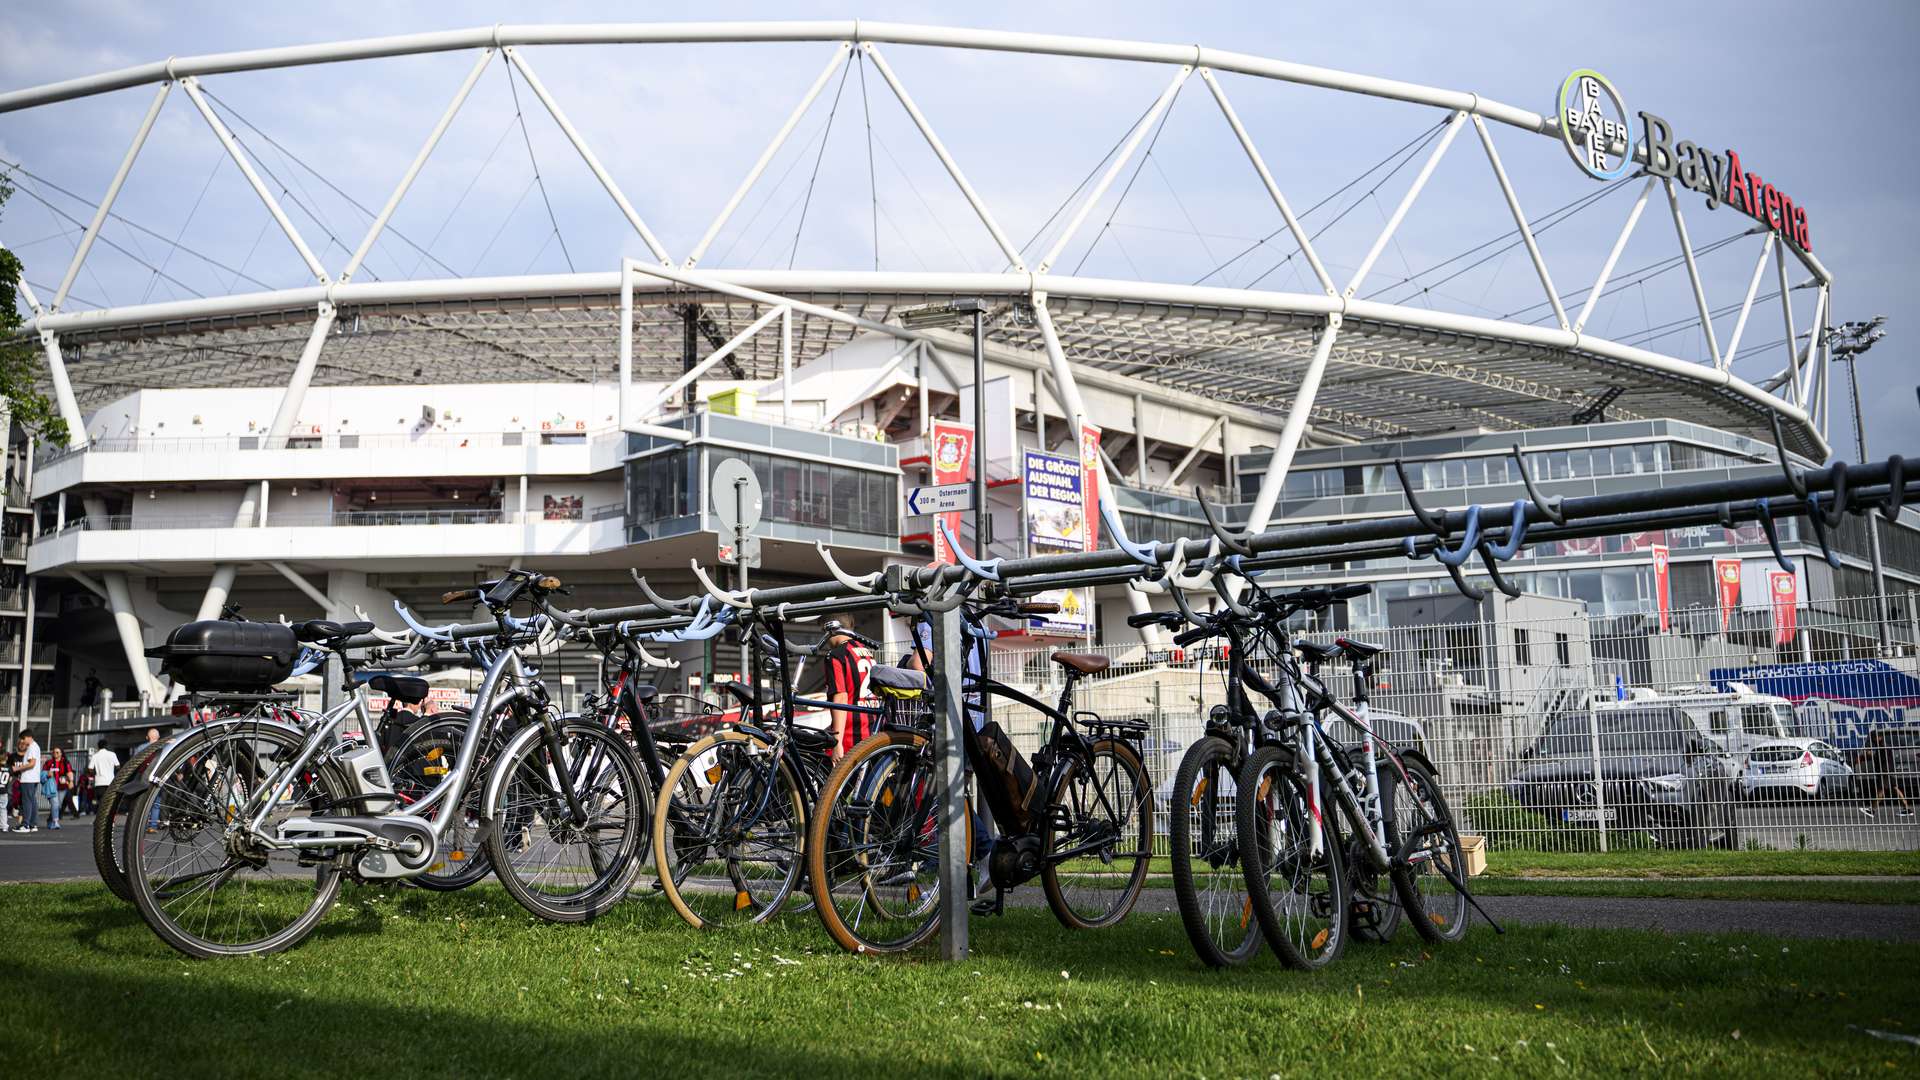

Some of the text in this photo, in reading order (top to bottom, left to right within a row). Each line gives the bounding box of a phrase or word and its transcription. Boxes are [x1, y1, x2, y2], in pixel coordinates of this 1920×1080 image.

[1565, 107, 1628, 141] BAYER
[1581, 77, 1608, 170] BAYER
[1638, 111, 1812, 252] BayArena
[542, 421, 551, 430] E5
[1028, 457, 1080, 477] DIE GRÖSST
[1029, 470, 1074, 489] AUSWAHL
[938, 488, 968, 497] Ostermann
[1029, 484, 1049, 498] DER
